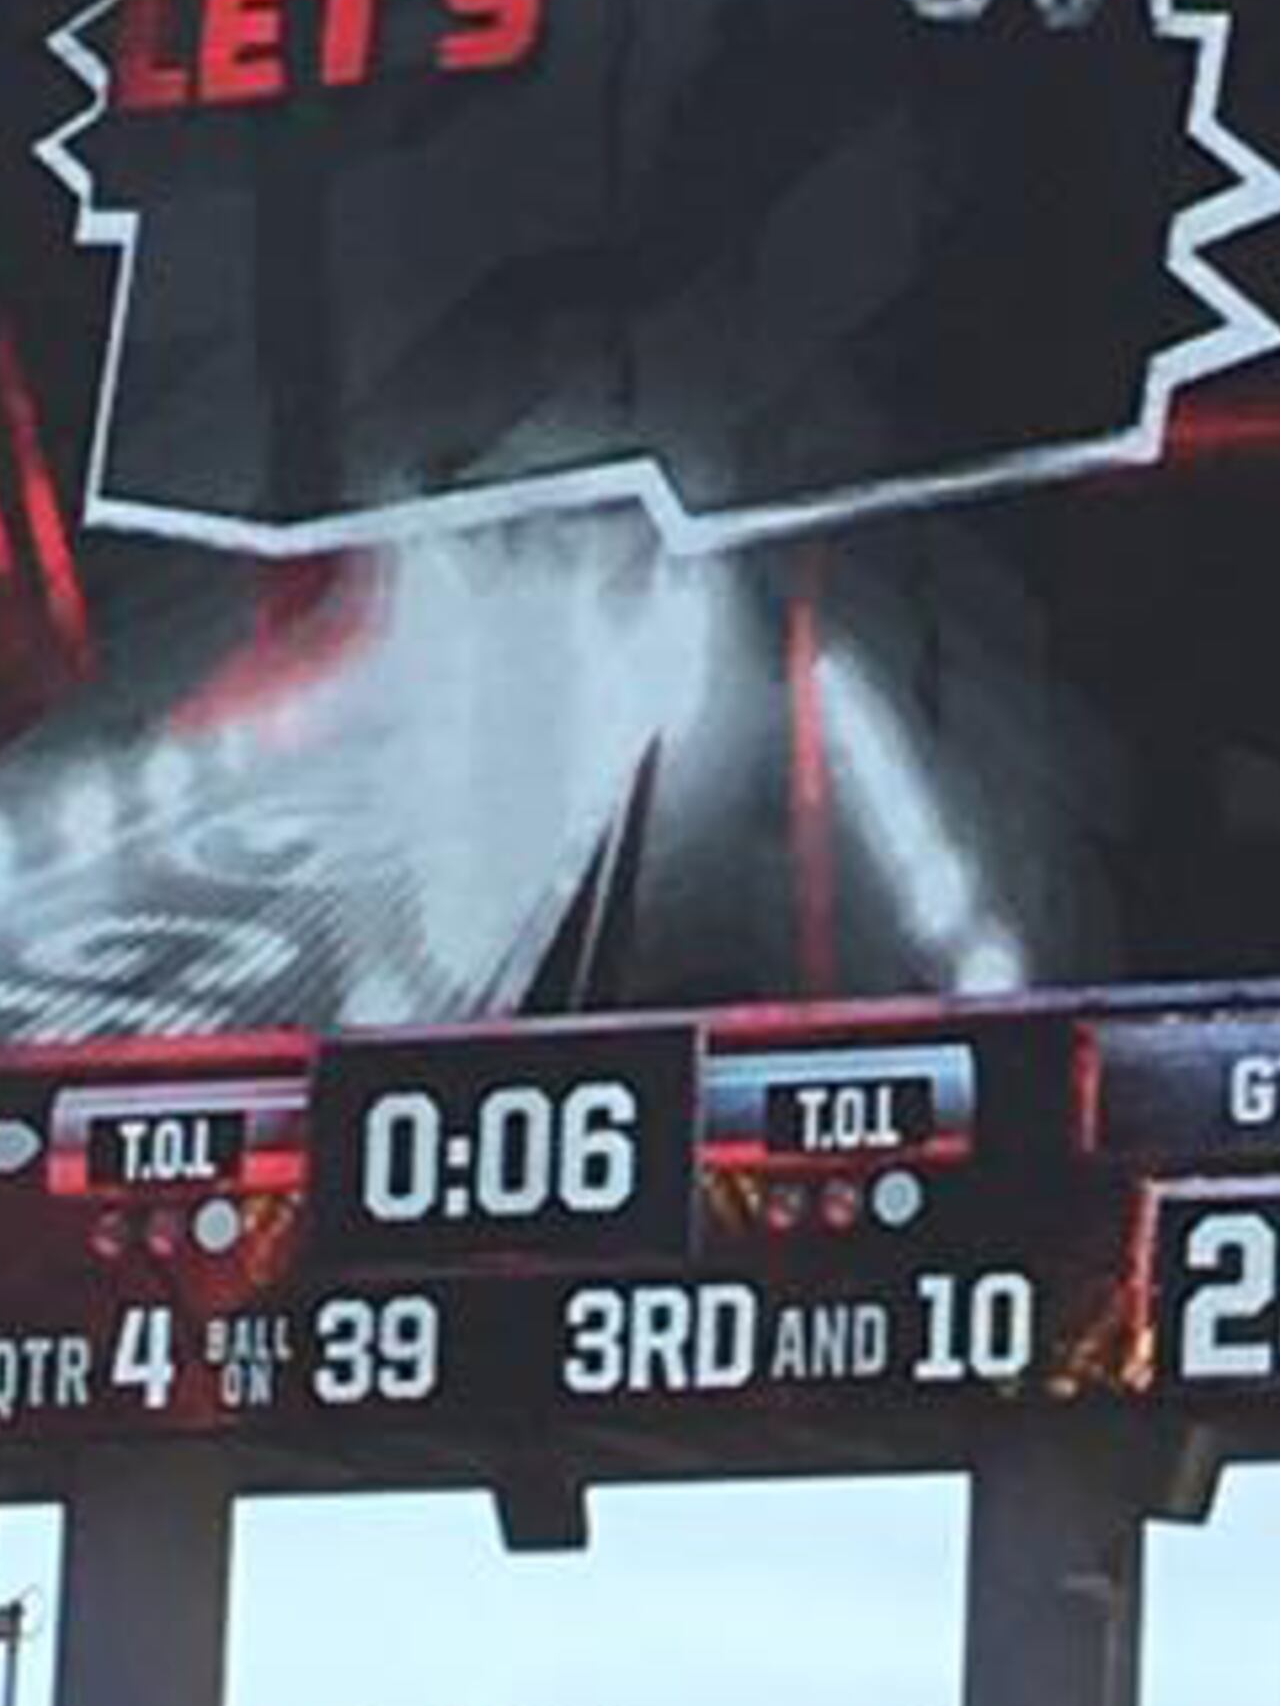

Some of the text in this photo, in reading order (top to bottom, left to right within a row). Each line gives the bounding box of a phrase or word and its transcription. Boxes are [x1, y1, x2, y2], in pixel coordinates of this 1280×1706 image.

[362, 1081, 638, 1223] 0:06
[111, 1307, 173, 1409] 4
[314, 1296, 437, 1405] 39
[563, 1273, 1032, 1394] 3RD AND 10
